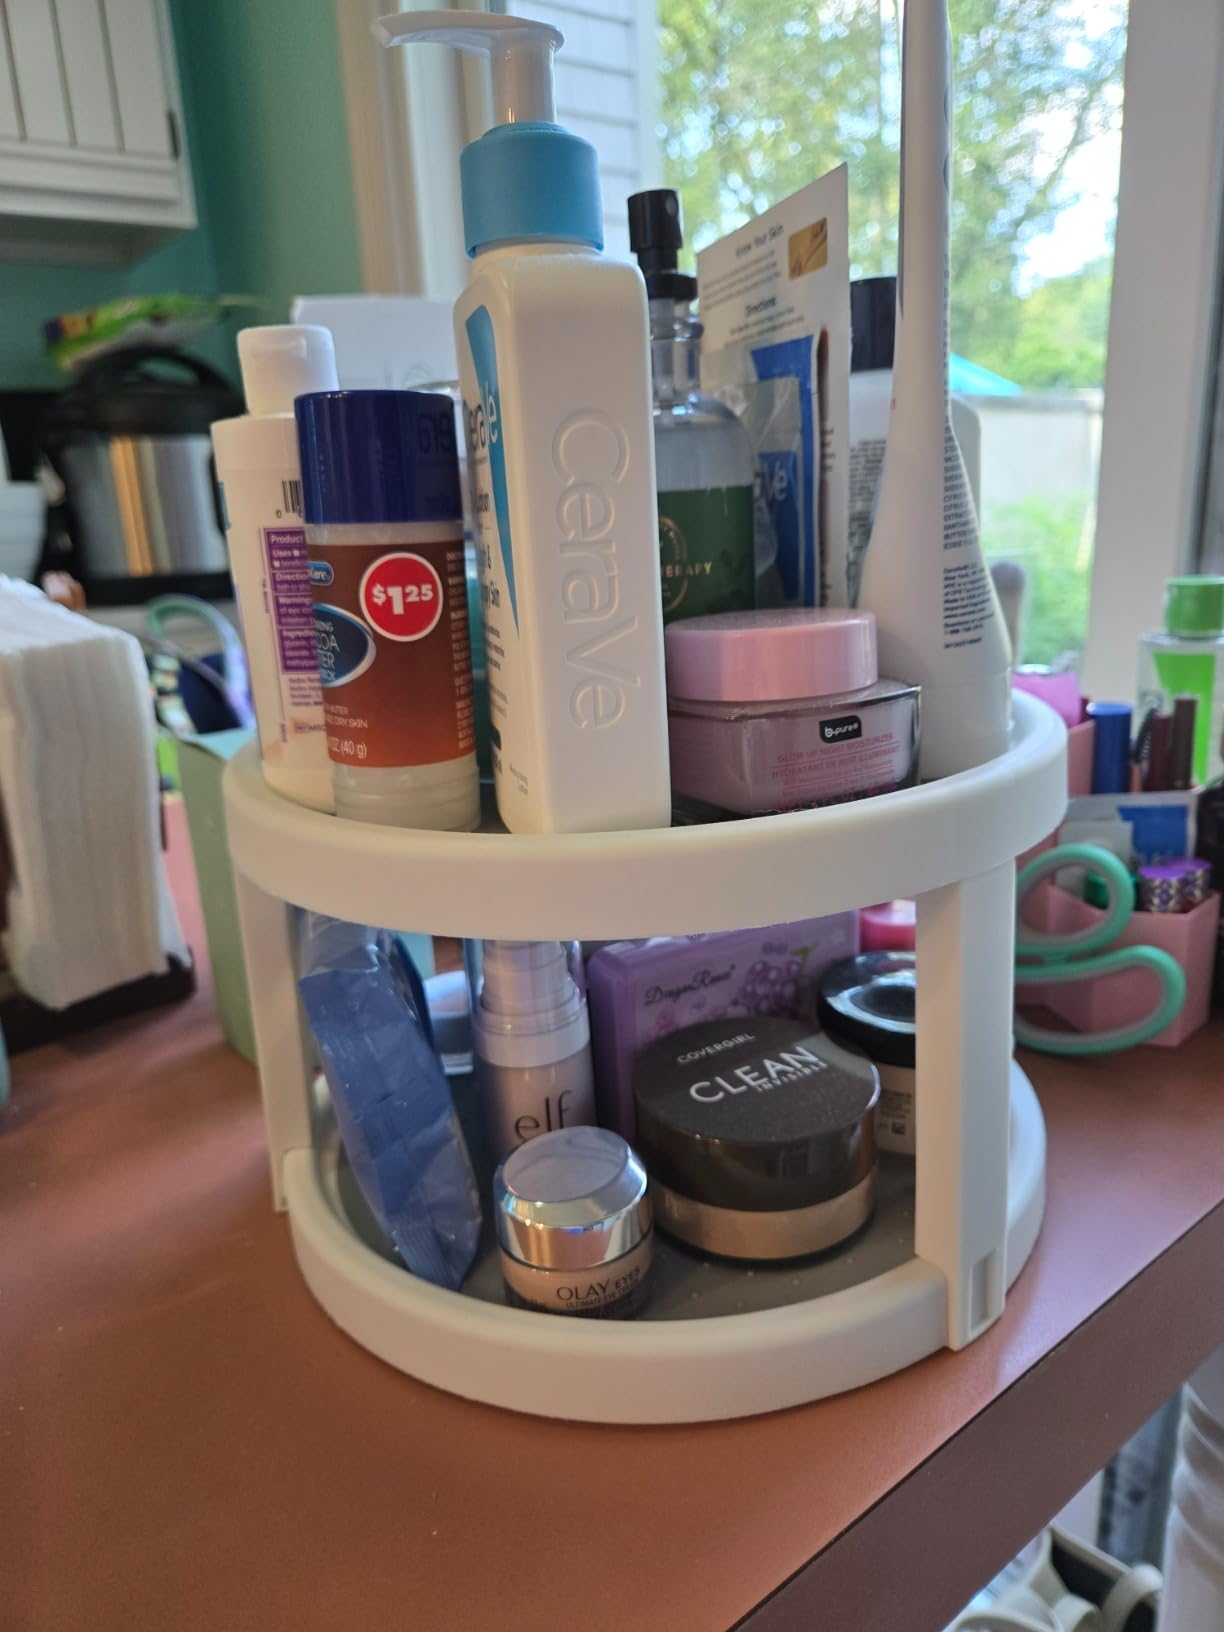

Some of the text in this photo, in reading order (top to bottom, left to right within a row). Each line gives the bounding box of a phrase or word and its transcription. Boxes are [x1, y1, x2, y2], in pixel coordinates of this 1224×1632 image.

[552, 409, 640, 730] CeraVe
[677, 1033, 756, 1064] COVERGIRL
[689, 1046, 819, 1104] CLEAN
[556, 1278, 610, 1301] OLAY
